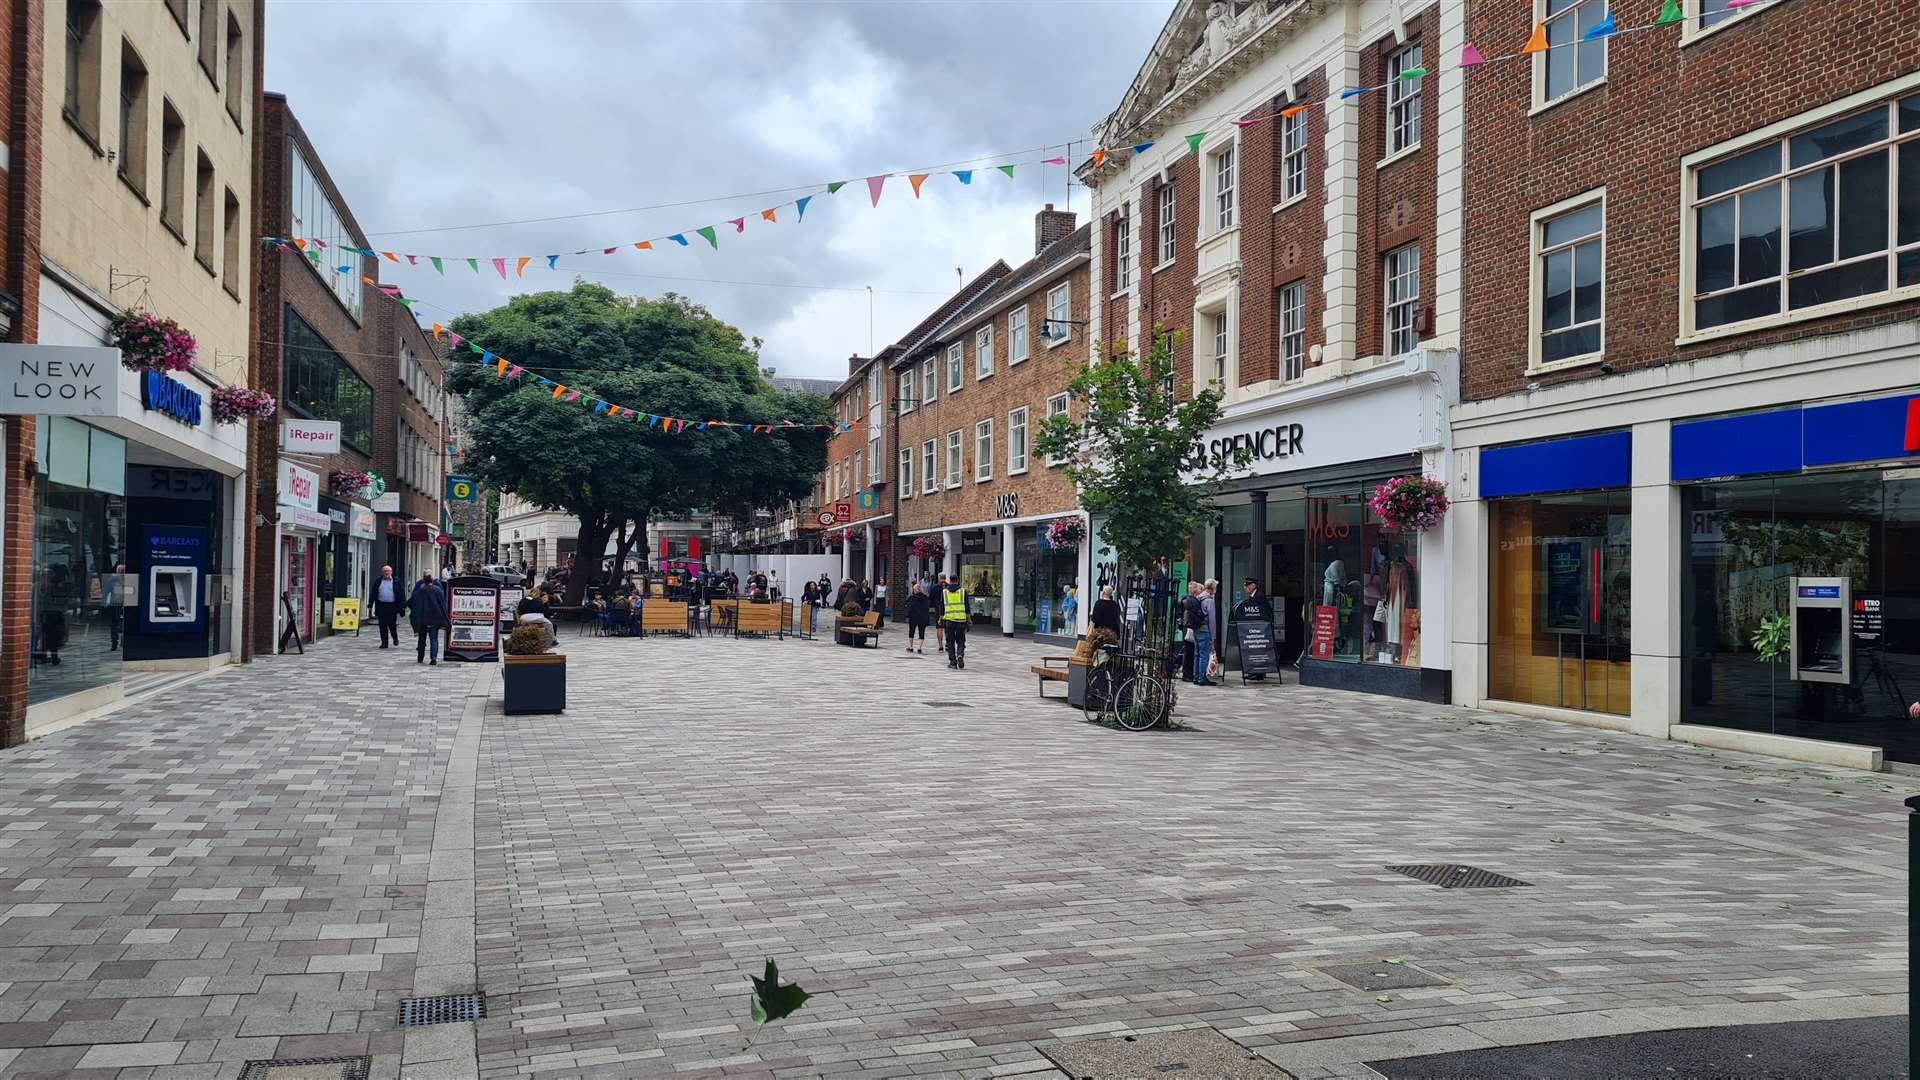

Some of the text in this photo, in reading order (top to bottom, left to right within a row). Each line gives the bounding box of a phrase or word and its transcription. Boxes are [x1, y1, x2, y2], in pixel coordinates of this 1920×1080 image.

[21, 360, 95, 377] NEW
[14, 382, 102, 400] LOOK
[159, 373, 202, 426] BARCLAYS
[290, 429, 334, 442] iRepair
[1210, 422, 1304, 466] SPENCER
[288, 466, 312, 504] iRepair
[996, 492, 1018, 518] M&S
[1307, 511, 1350, 539] M&S
[1096, 562, 1118, 594] 20%
